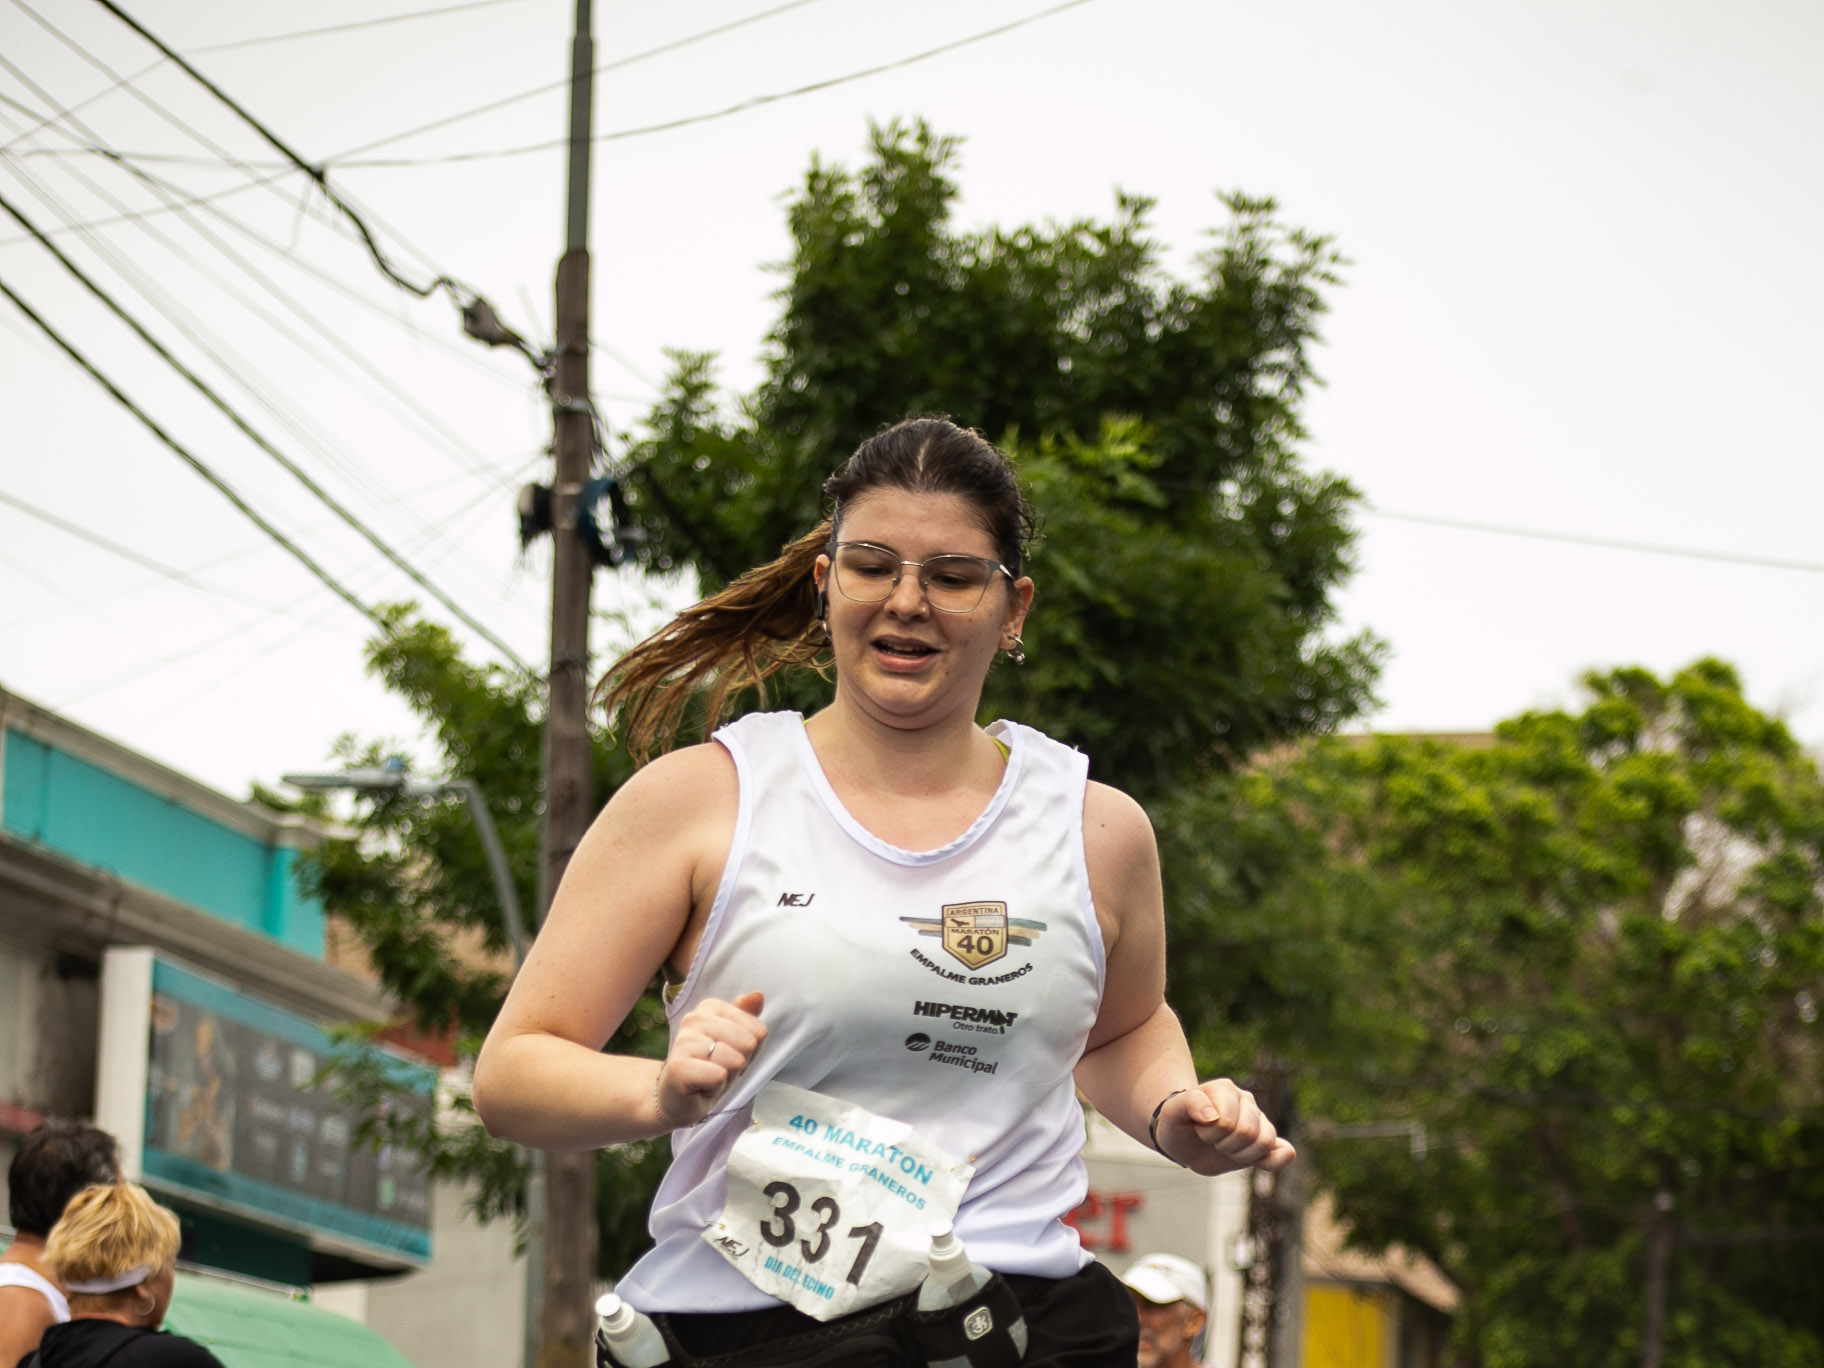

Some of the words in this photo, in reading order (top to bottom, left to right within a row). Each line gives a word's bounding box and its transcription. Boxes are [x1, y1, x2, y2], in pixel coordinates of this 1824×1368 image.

[949, 907, 1000, 916] ARGENTINA
[950, 927, 1000, 935] MARATÓN
[956, 935, 994, 956] 40
[910, 948, 967, 984] EMPALME
[968, 962, 1033, 986] GRANEROS
[952, 1021, 974, 1031] Otro
[934, 1041, 978, 1056] Banco
[928, 1052, 999, 1075] Municipal
[789, 1114, 818, 1135] 40
[823, 1123, 935, 1186] MARATON
[772, 1136, 845, 1169] EMPALME
[848, 1162, 926, 1210] GRANEROS
[760, 1181, 884, 1286] 331
[802, 1273, 836, 1300] ECINO
